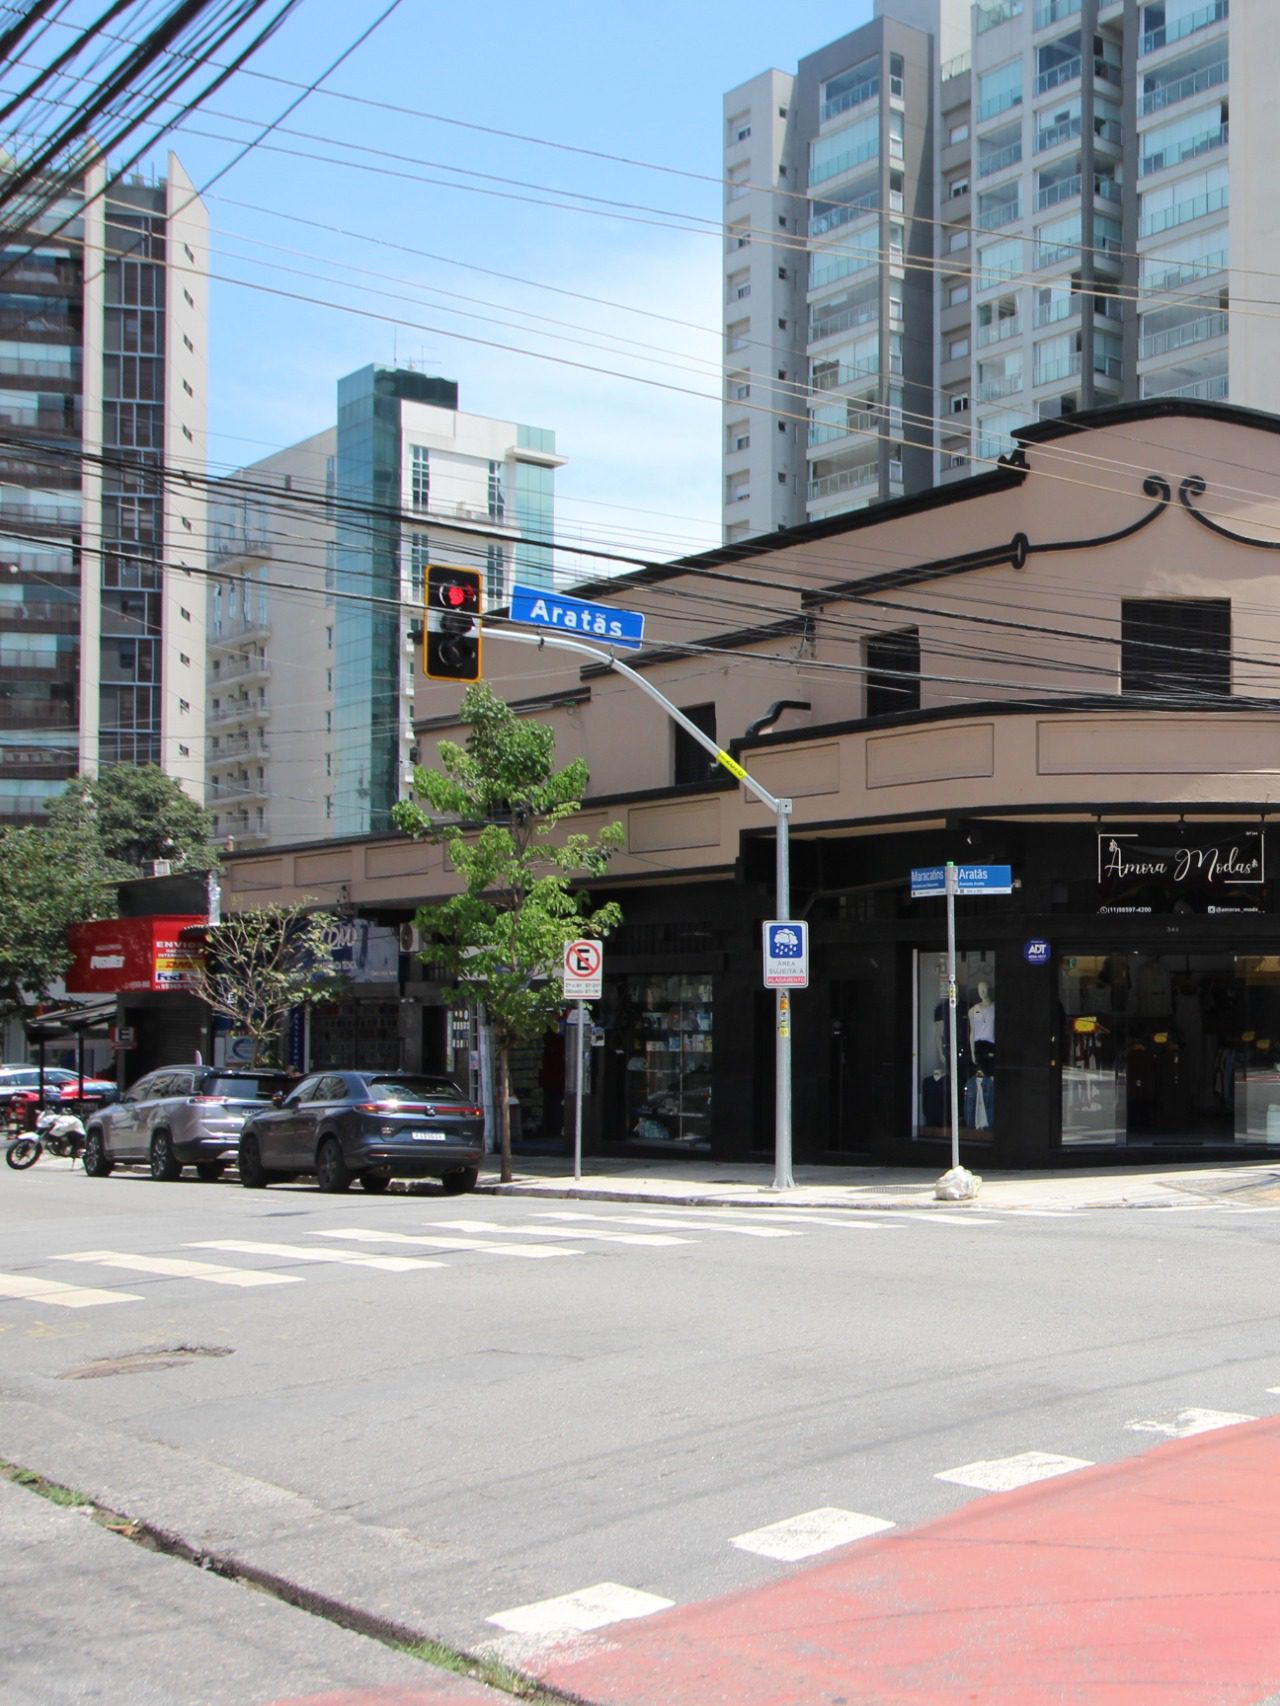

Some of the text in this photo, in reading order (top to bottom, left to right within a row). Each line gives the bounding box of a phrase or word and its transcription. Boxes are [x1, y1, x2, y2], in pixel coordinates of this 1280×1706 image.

[530, 599, 623, 637] Aratãs
[959, 868, 988, 880] Aratãs
[1104, 846, 1252, 883] Amora Modas
[1028, 943, 1047, 955] ADT
